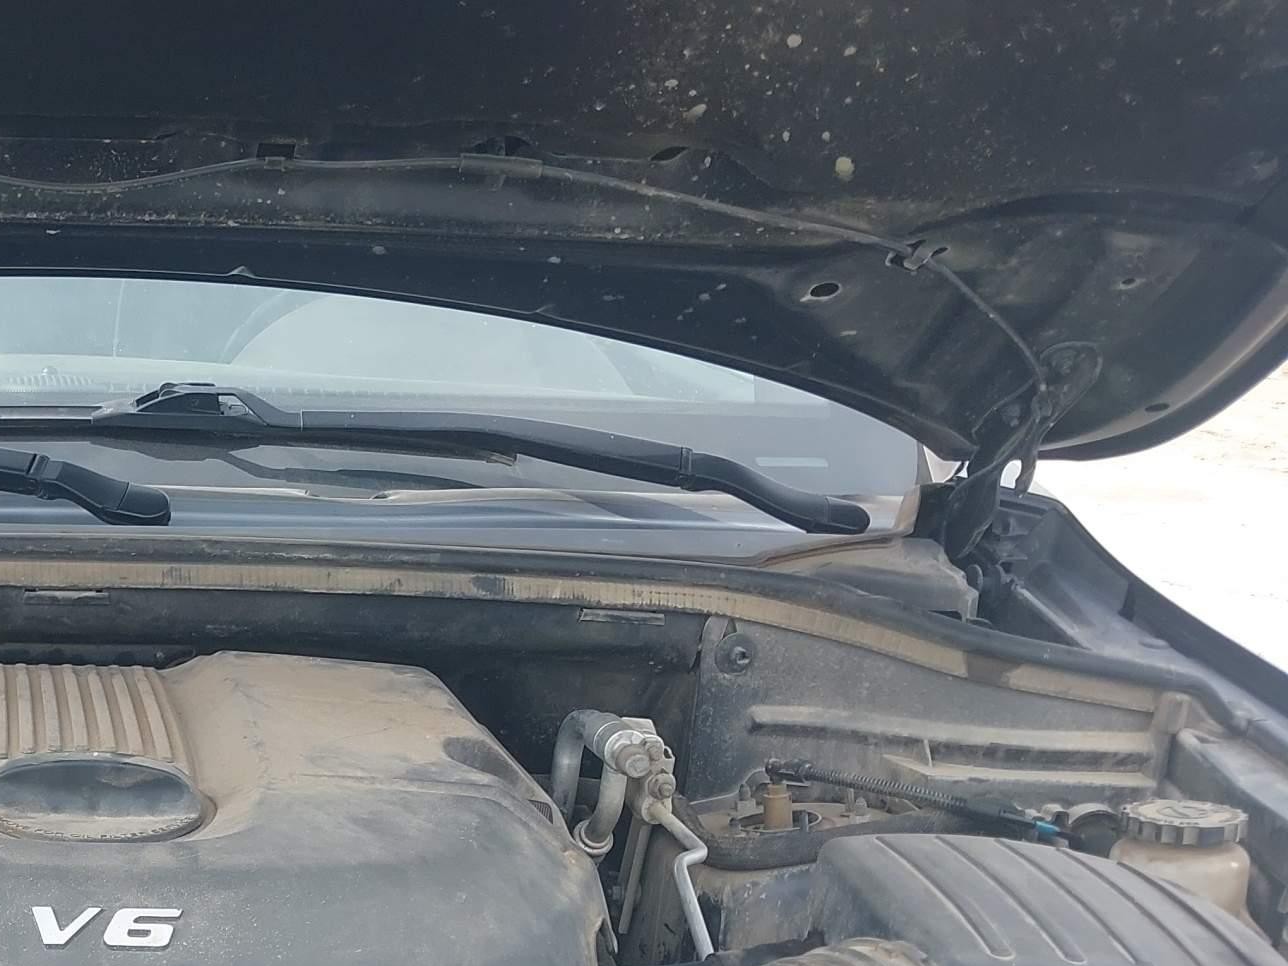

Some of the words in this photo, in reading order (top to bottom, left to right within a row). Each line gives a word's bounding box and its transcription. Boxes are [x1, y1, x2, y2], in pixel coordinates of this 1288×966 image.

[34, 829, 65, 839] FOR
[70, 832, 94, 840] OIL
[100, 831, 145, 840] FILTER
[31, 906, 182, 948] V6
